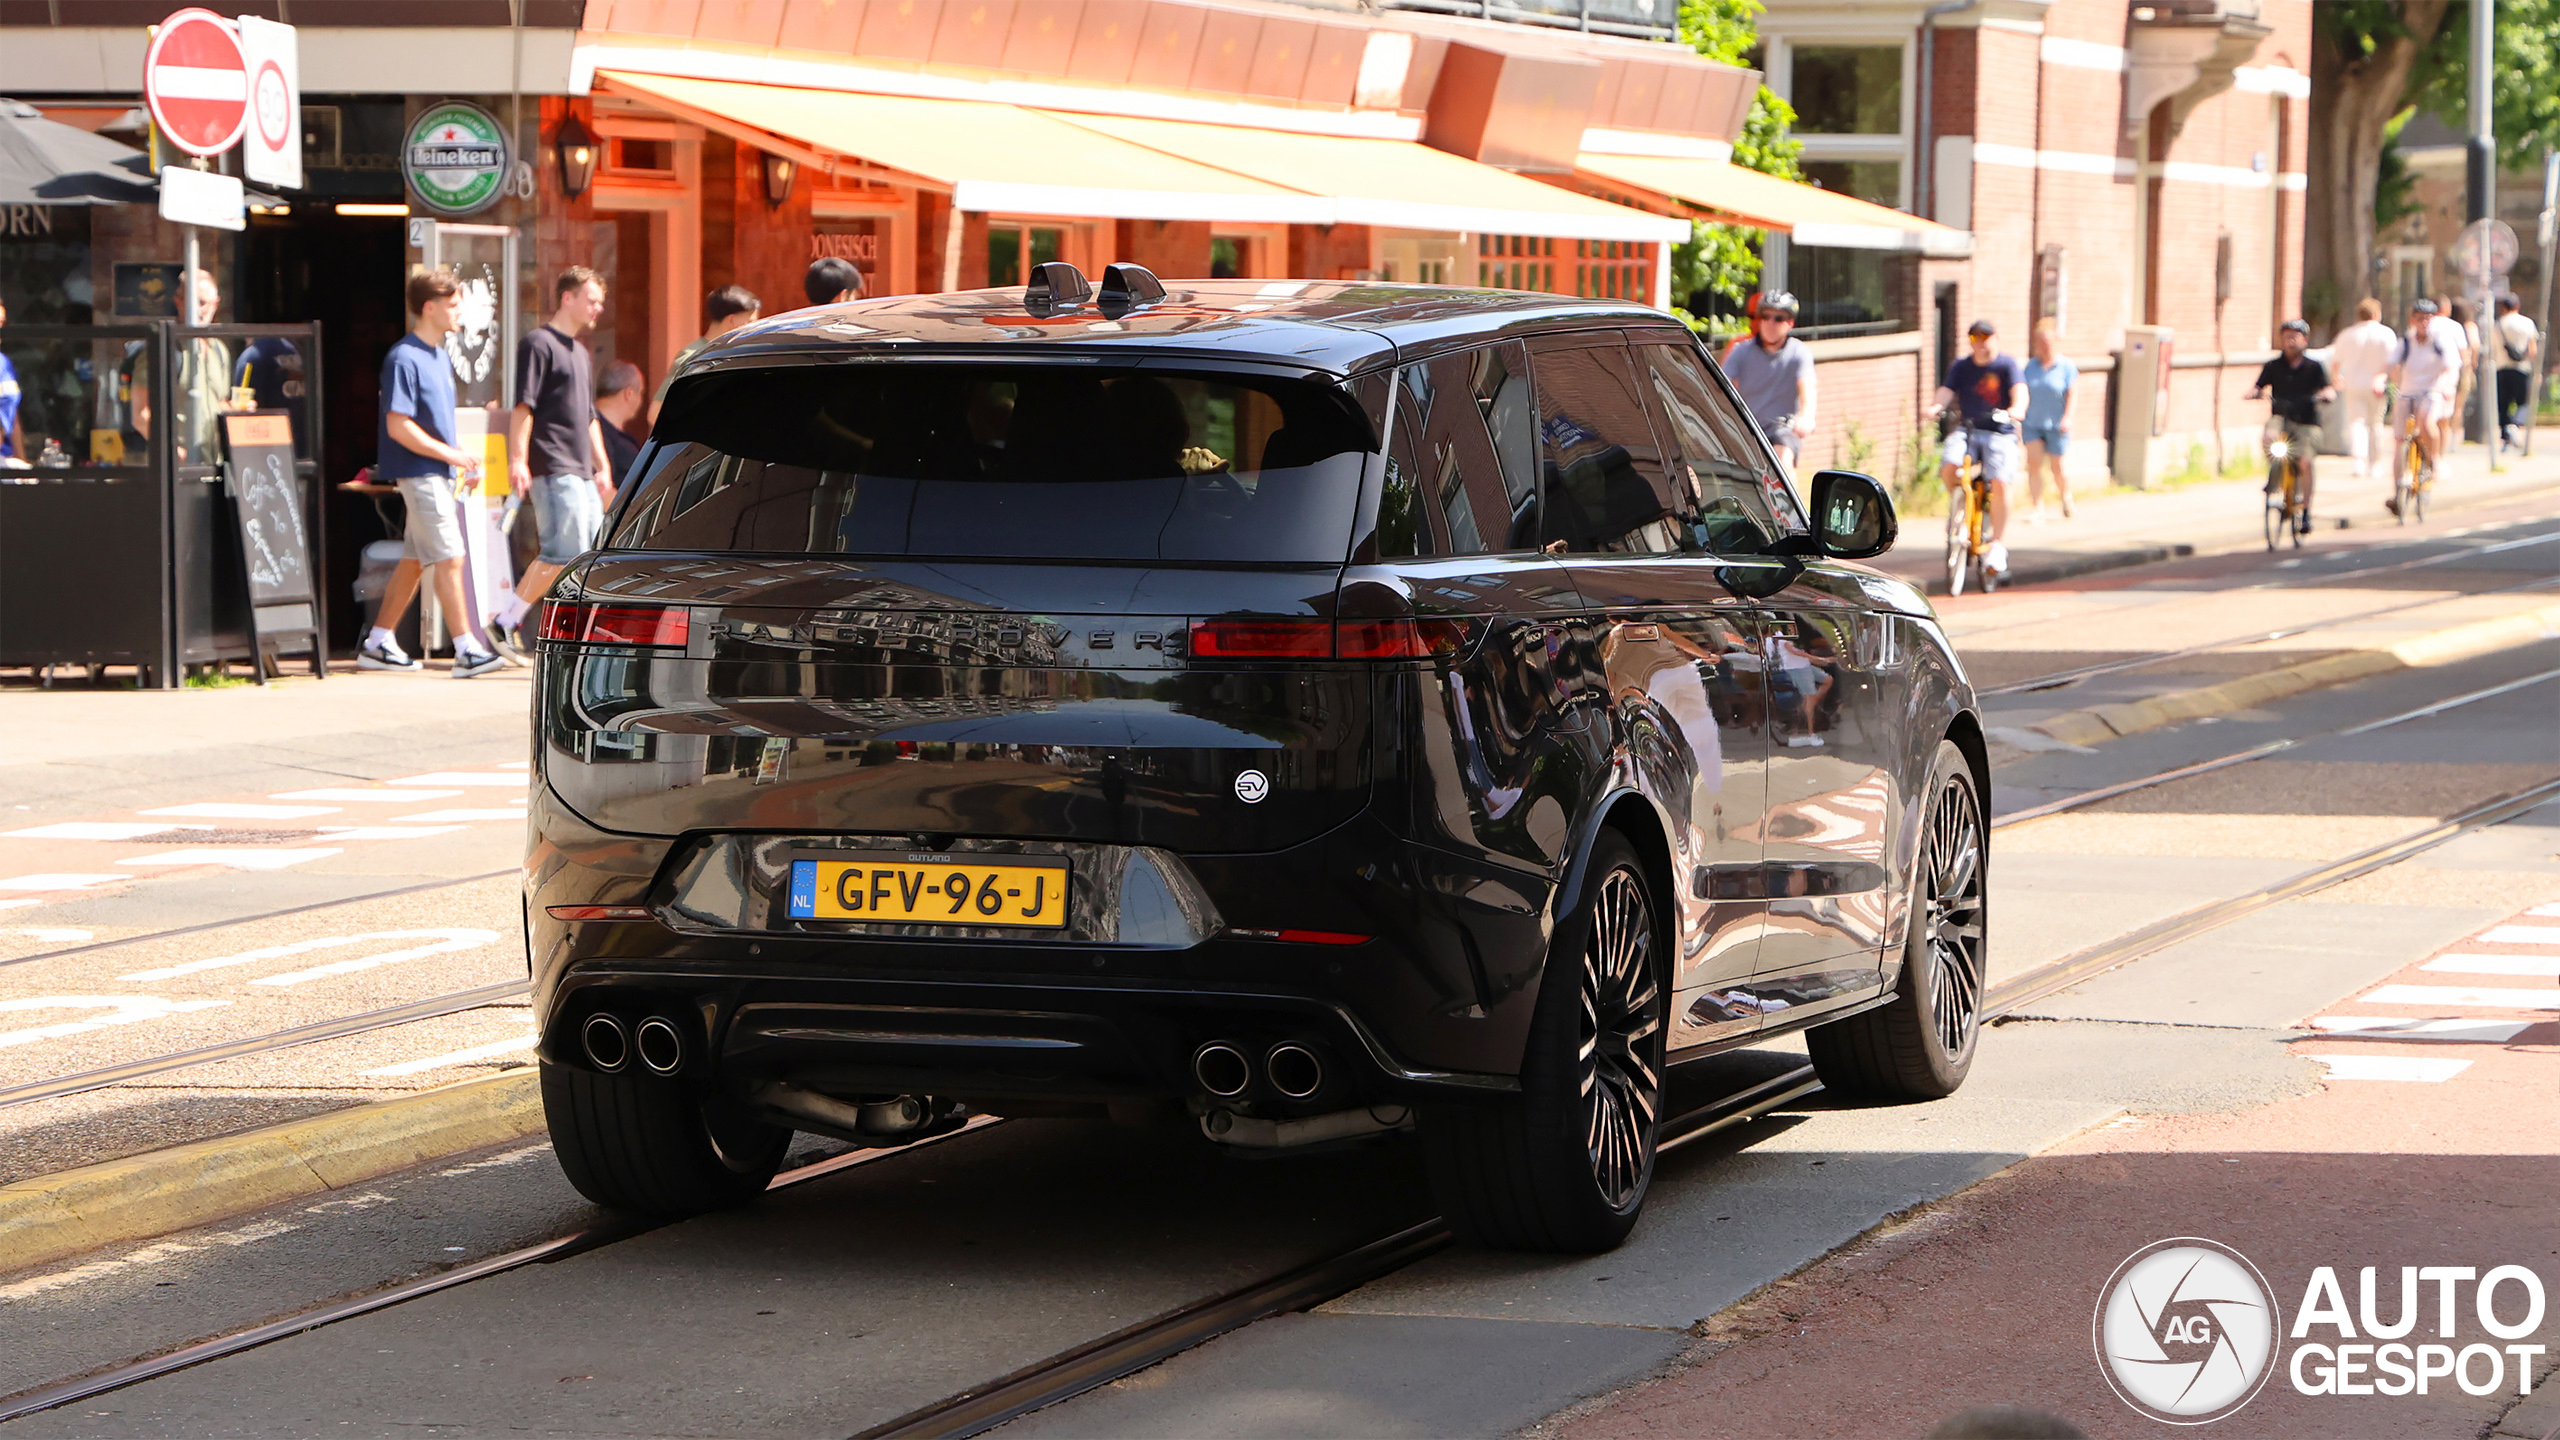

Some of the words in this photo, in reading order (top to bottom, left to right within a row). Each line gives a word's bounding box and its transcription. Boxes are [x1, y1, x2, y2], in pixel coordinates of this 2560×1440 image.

[413, 147, 495, 166] Heineken
[708, 622, 901, 646] RANGE
[950, 627, 1164, 651] ROVER
[908, 854, 951, 862] OUTLAND
[793, 894, 811, 908] NL
[836, 868, 1044, 918] GFV-96-J
